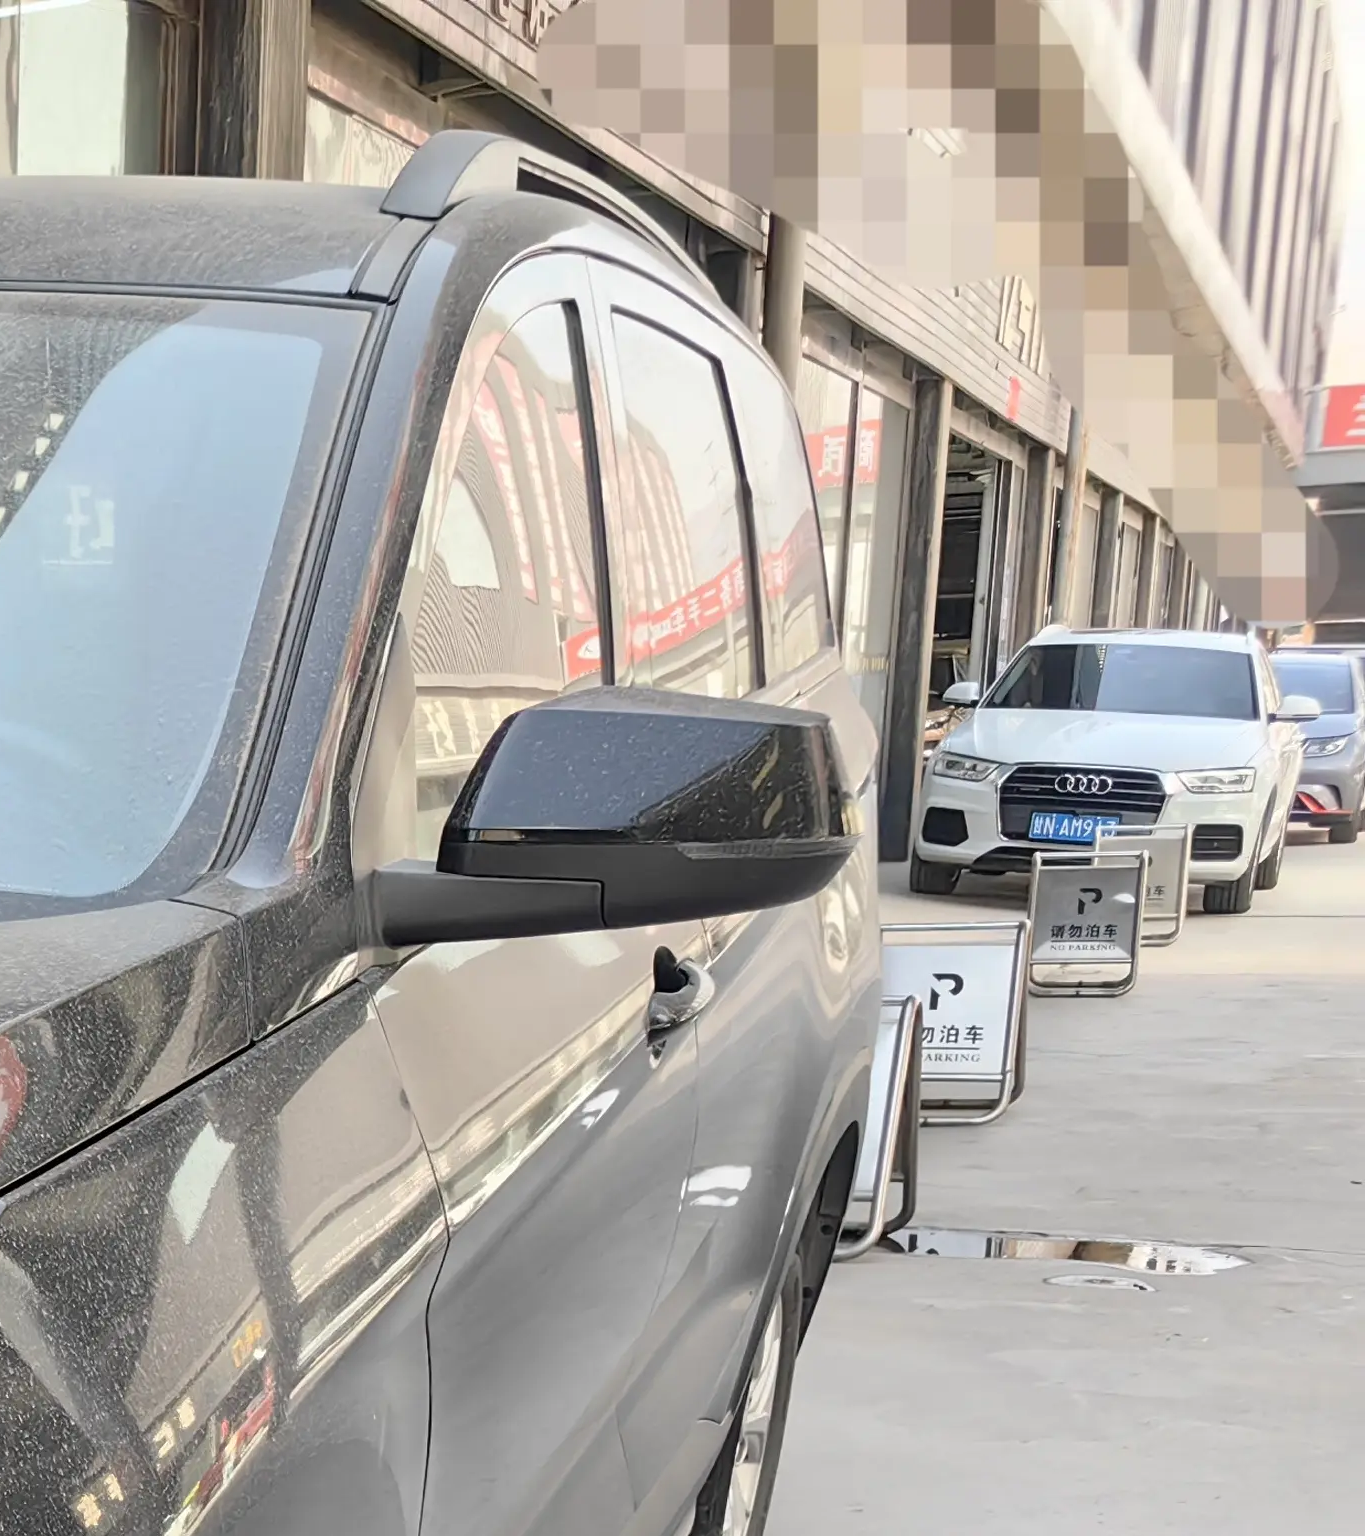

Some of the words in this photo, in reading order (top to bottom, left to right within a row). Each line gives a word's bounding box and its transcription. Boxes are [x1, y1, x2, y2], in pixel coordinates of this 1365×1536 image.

[1050, 924, 1118, 939] 请勿泊车
[1050, 943, 1066, 951] NO
[1068, 943, 1116, 951] PARKING
[922, 1025, 984, 1044] 勿泊车
[922, 1052, 981, 1063] ARKING
